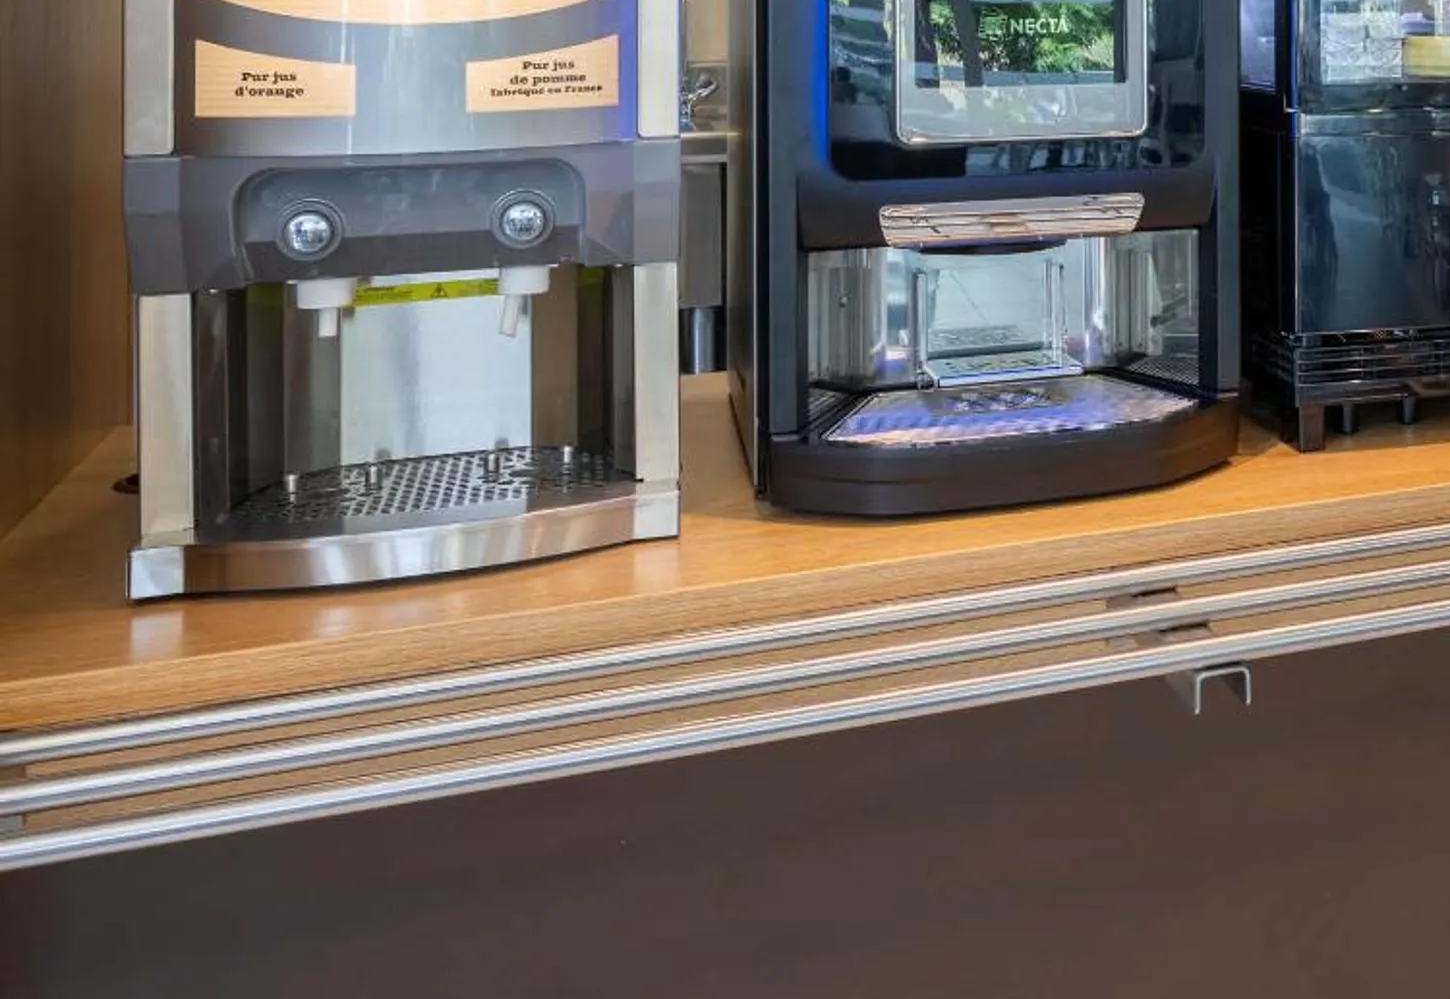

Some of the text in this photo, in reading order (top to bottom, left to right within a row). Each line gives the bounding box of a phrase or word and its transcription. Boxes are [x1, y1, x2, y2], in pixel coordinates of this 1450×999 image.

[1009, 17, 1070, 34] NECTA
[522, 59, 575, 72] Pur jus
[241, 70, 297, 85] Pur jus
[510, 73, 587, 87] de pomme
[235, 85, 305, 99] d'orange
[564, 84, 603, 94] France
